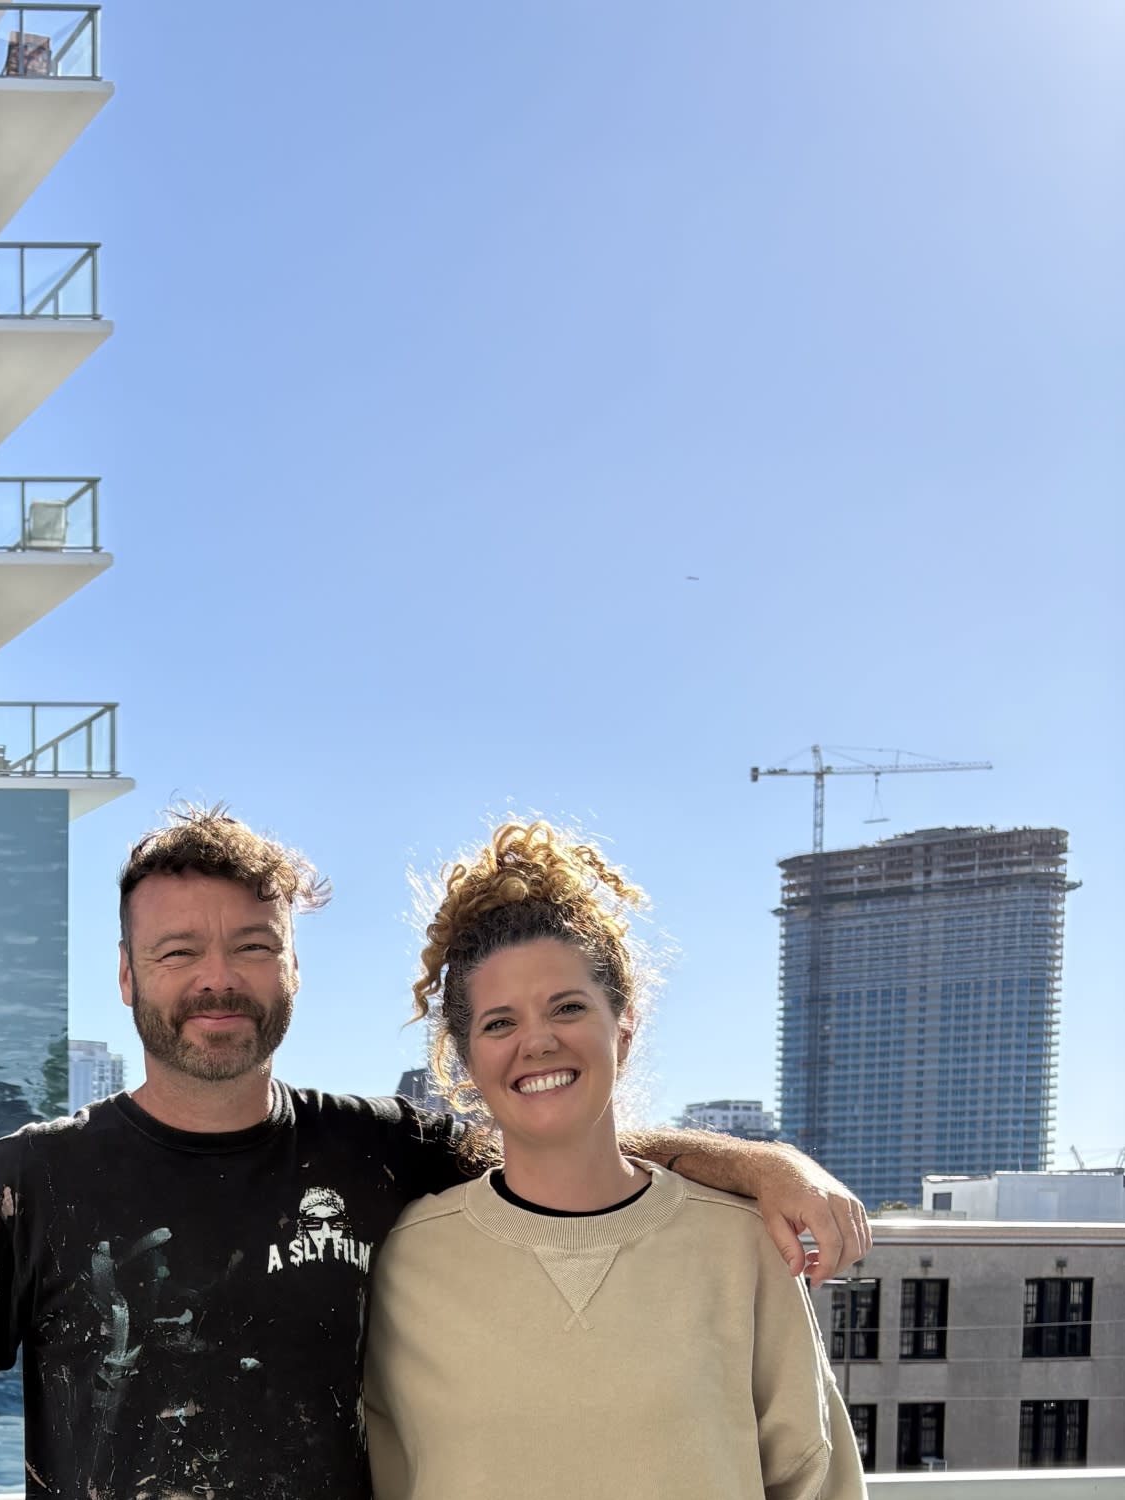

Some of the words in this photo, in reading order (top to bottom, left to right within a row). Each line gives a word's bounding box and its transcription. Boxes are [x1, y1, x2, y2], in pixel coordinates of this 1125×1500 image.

[267, 1243, 283, 1274] A
[289, 1236, 326, 1268] SLY
[333, 1237, 371, 1275] FILM
